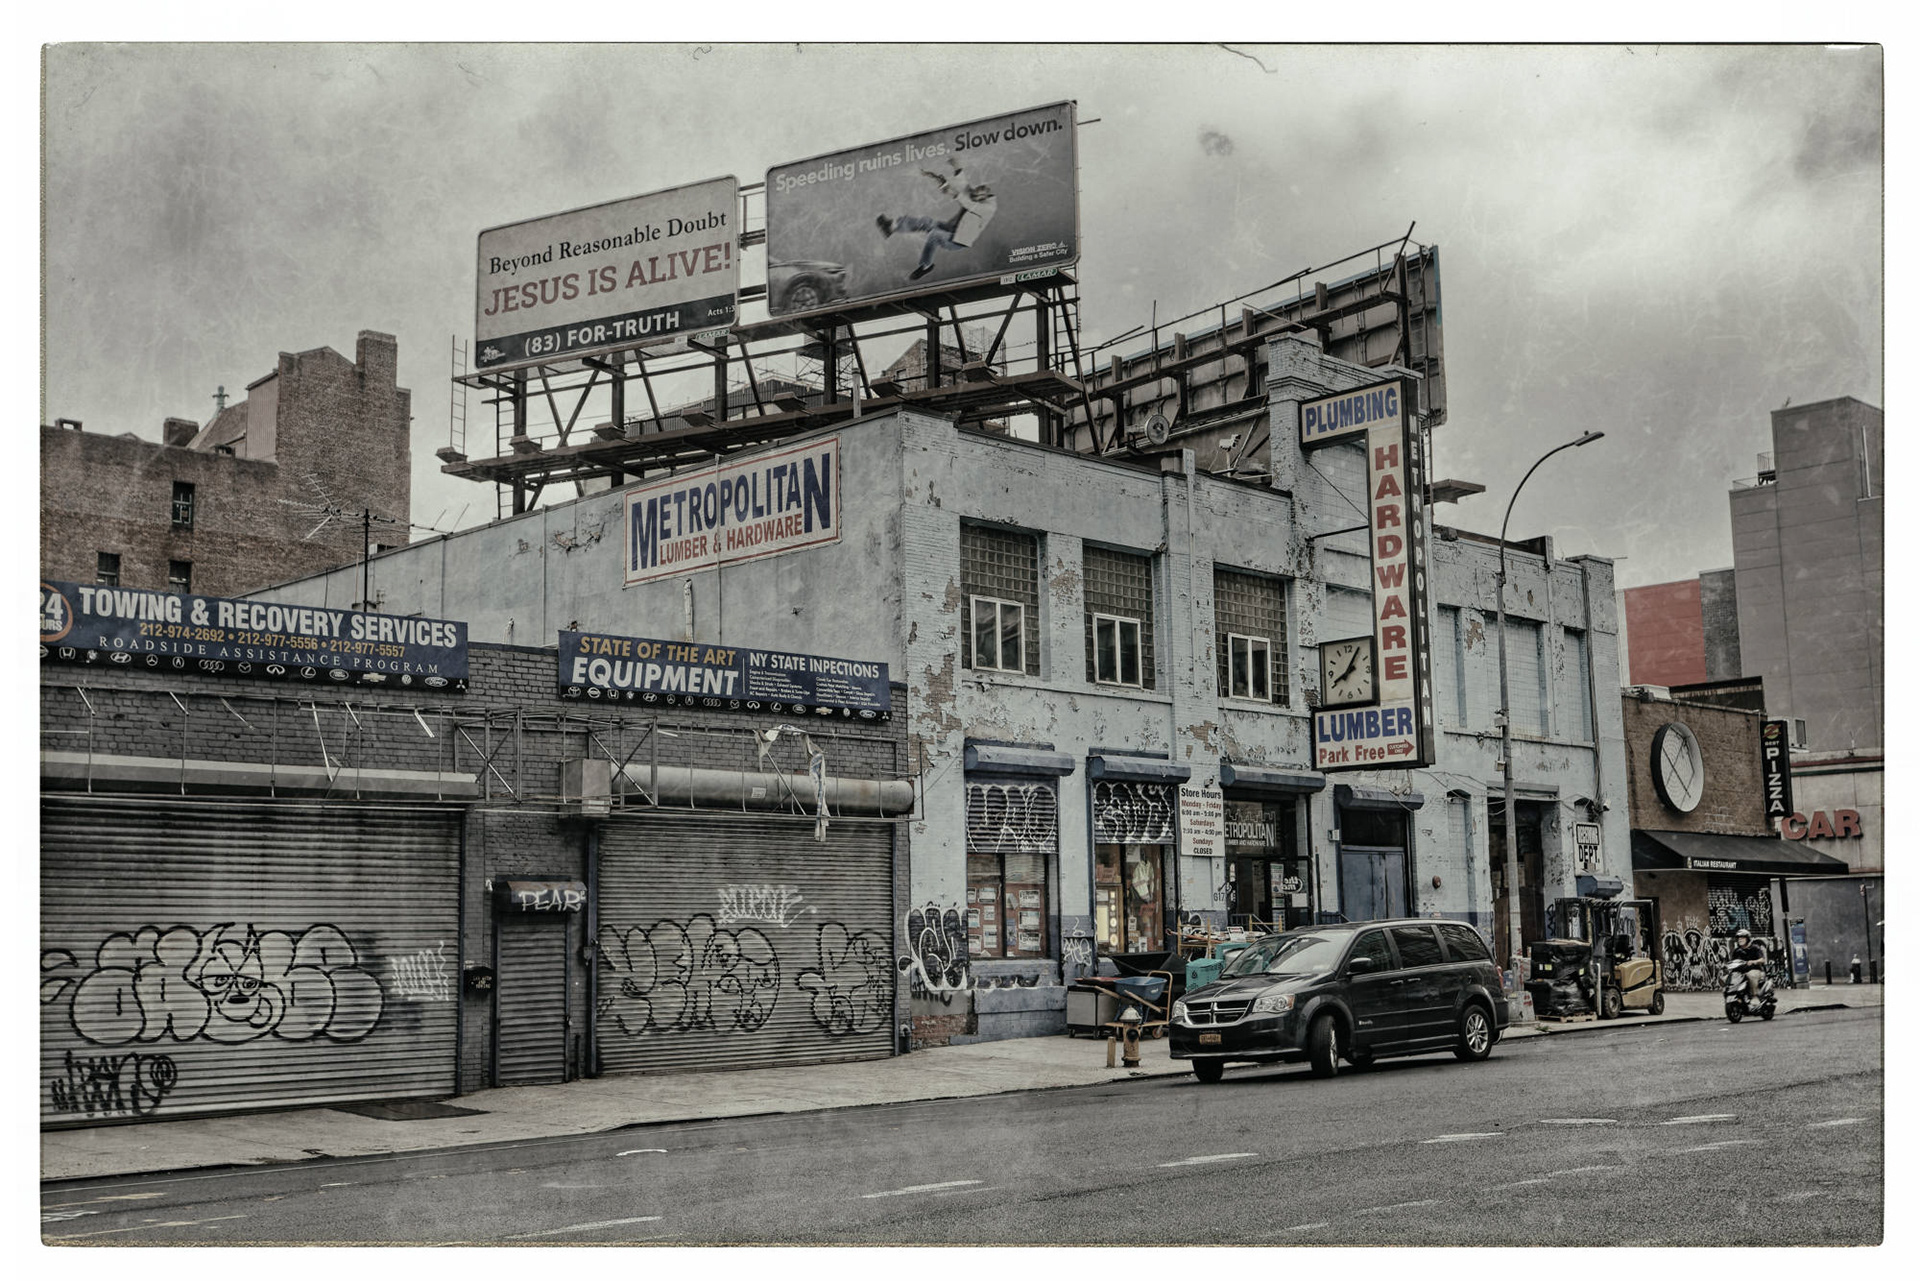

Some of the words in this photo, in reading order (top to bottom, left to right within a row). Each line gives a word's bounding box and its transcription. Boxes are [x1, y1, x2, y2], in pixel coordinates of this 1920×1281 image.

[776, 162, 855, 194] Speeding
[859, 152, 902, 173] ruins
[905, 141, 951, 163] lives.
[954, 130, 1000, 152] Slow
[1003, 117, 1063, 142] down.
[489, 245, 553, 276] Beyond
[559, 225, 661, 260] Reasonable
[668, 211, 727, 238] Doubt
[1011, 245, 1036, 256] VISION
[1036, 242, 1057, 252] ZERO
[484, 273, 580, 317] JESUS
[588, 265, 617, 296] IS
[625, 241, 731, 288] ALIVE!
[1021, 268, 1053, 281] LAMAR
[707, 308, 723, 317] Acts
[524, 332, 560, 357] (83)
[567, 311, 680, 347] FOR-TRUTH
[1305, 387, 1398, 436] PLUMBING
[631, 453, 830, 571] METROPOLITAN
[660, 535, 708, 566] LUMBER
[713, 537, 721, 554] &
[727, 514, 803, 551] HARDWARE
[1374, 443, 1408, 681] HARDWARE
[1409, 414, 1431, 726] METROPOLITAN
[78, 587, 182, 623] TOWING
[190, 599, 210, 626] &
[218, 601, 344, 638] RECOVERY
[351, 614, 457, 648] SERVICES
[139, 622, 225, 643] 212-974-2692
[238, 632, 318, 650] 212-977-5556
[330, 639, 406, 658] 212-977-5557
[579, 636, 632, 657] STATE
[637, 641, 661, 660] OF
[667, 645, 699, 663] THE
[703, 648, 736, 667] ART
[1344, 645, 1353, 653] 12
[99, 636, 207, 655] ROADSIDE
[220, 648, 341, 666] ASSISTANCE
[353, 657, 439, 674] PROGRAM
[750, 652, 768, 668] NY
[771, 654, 806, 671] STATE
[809, 658, 879, 679] INPECTIONS
[571, 656, 739, 696] EQUIPMENT
[1328, 670, 1334, 679] 9
[1365, 666, 1371, 674] 3
[1347, 691, 1353, 700] 6
[1317, 706, 1413, 743] LUMBER
[1318, 747, 1350, 765] Park
[1355, 744, 1385, 762] Free
[1181, 787, 1200, 798] Store
[1201, 789, 1222, 799] Hours
[1766, 747, 1785, 813] PIZZA
[1181, 800, 1202, 809] Monday
[1206, 801, 1222, 810] Friday
[1190, 819, 1215, 828] Saturdays
[1224, 821, 1275, 847] ETROPOLITAN
[1781, 809, 1863, 840] CAR
[1192, 837, 1214, 847] Sundays
[1193, 847, 1213, 855] CLOSED
[1578, 844, 1600, 863] DEPT.
[1710, 860, 1737, 869] RESTAURANT
